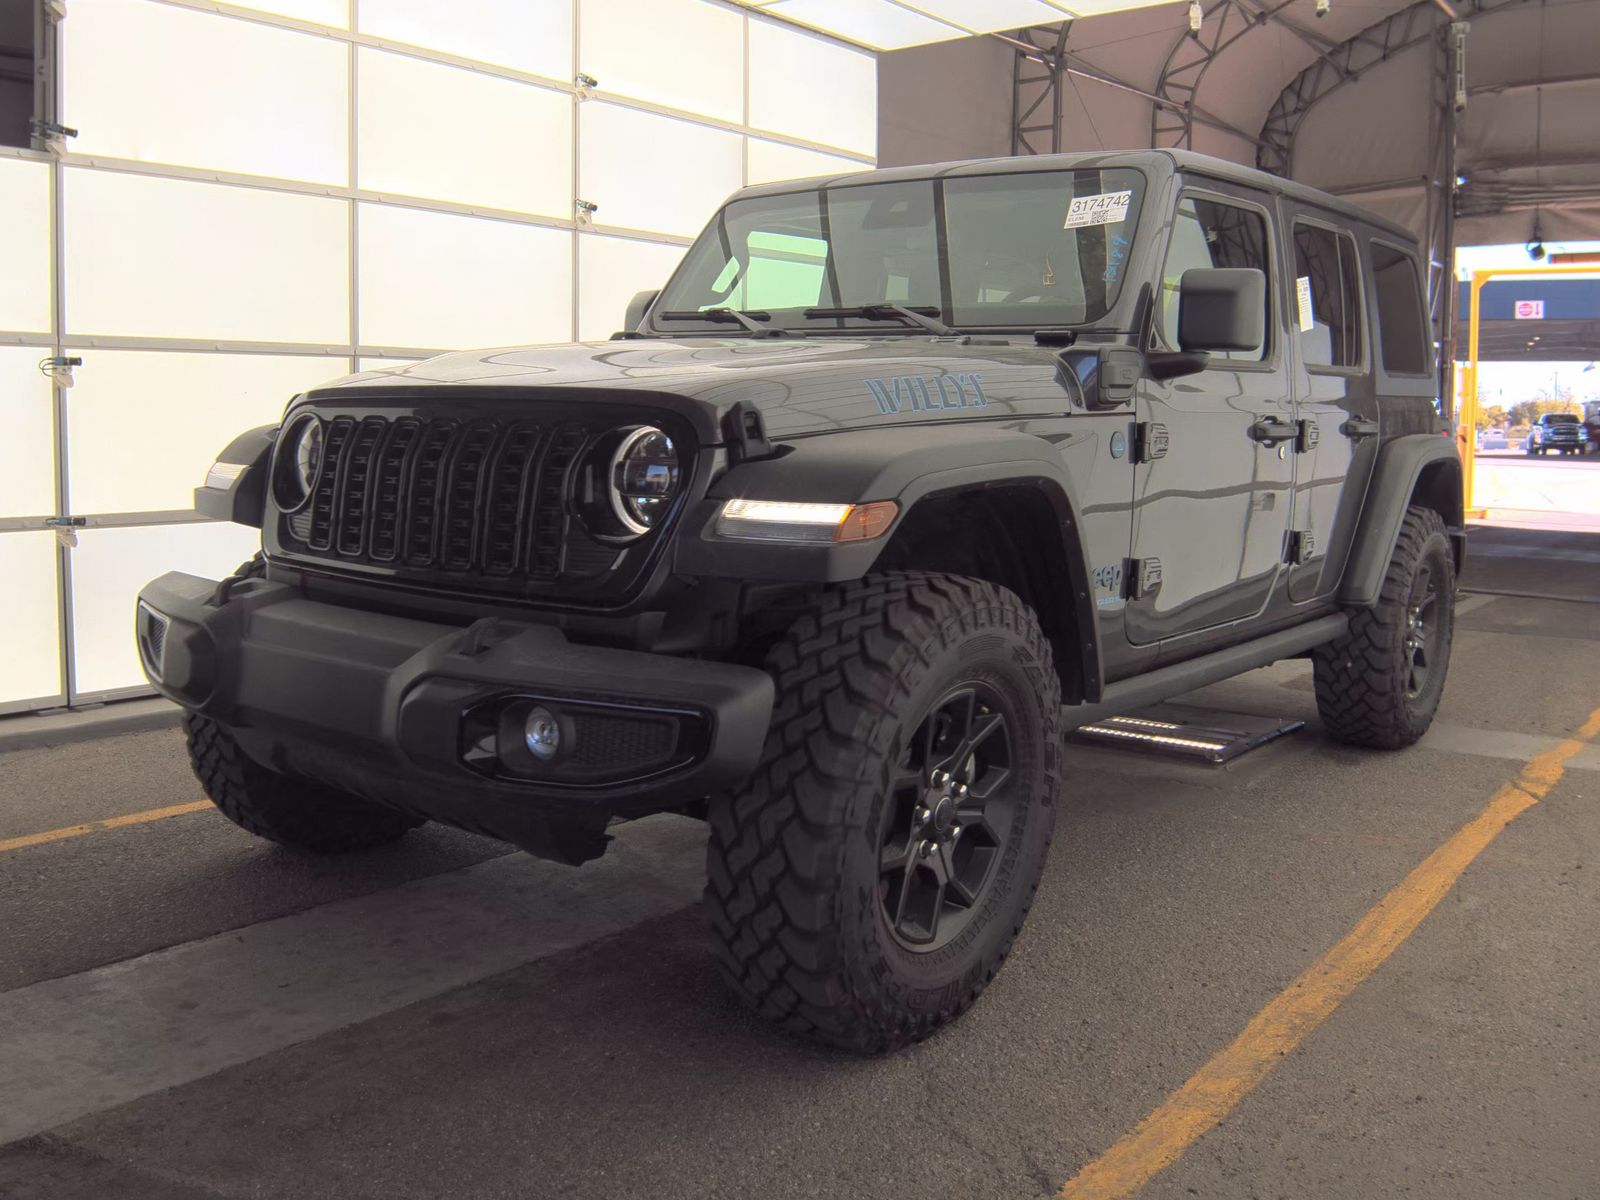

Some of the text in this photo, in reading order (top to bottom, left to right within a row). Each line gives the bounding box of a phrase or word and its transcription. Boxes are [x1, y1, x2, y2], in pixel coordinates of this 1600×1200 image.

[1072, 193, 1131, 213] 3174742
[863, 374, 988, 414] WILLYS
[1092, 565, 1121, 592] eep
